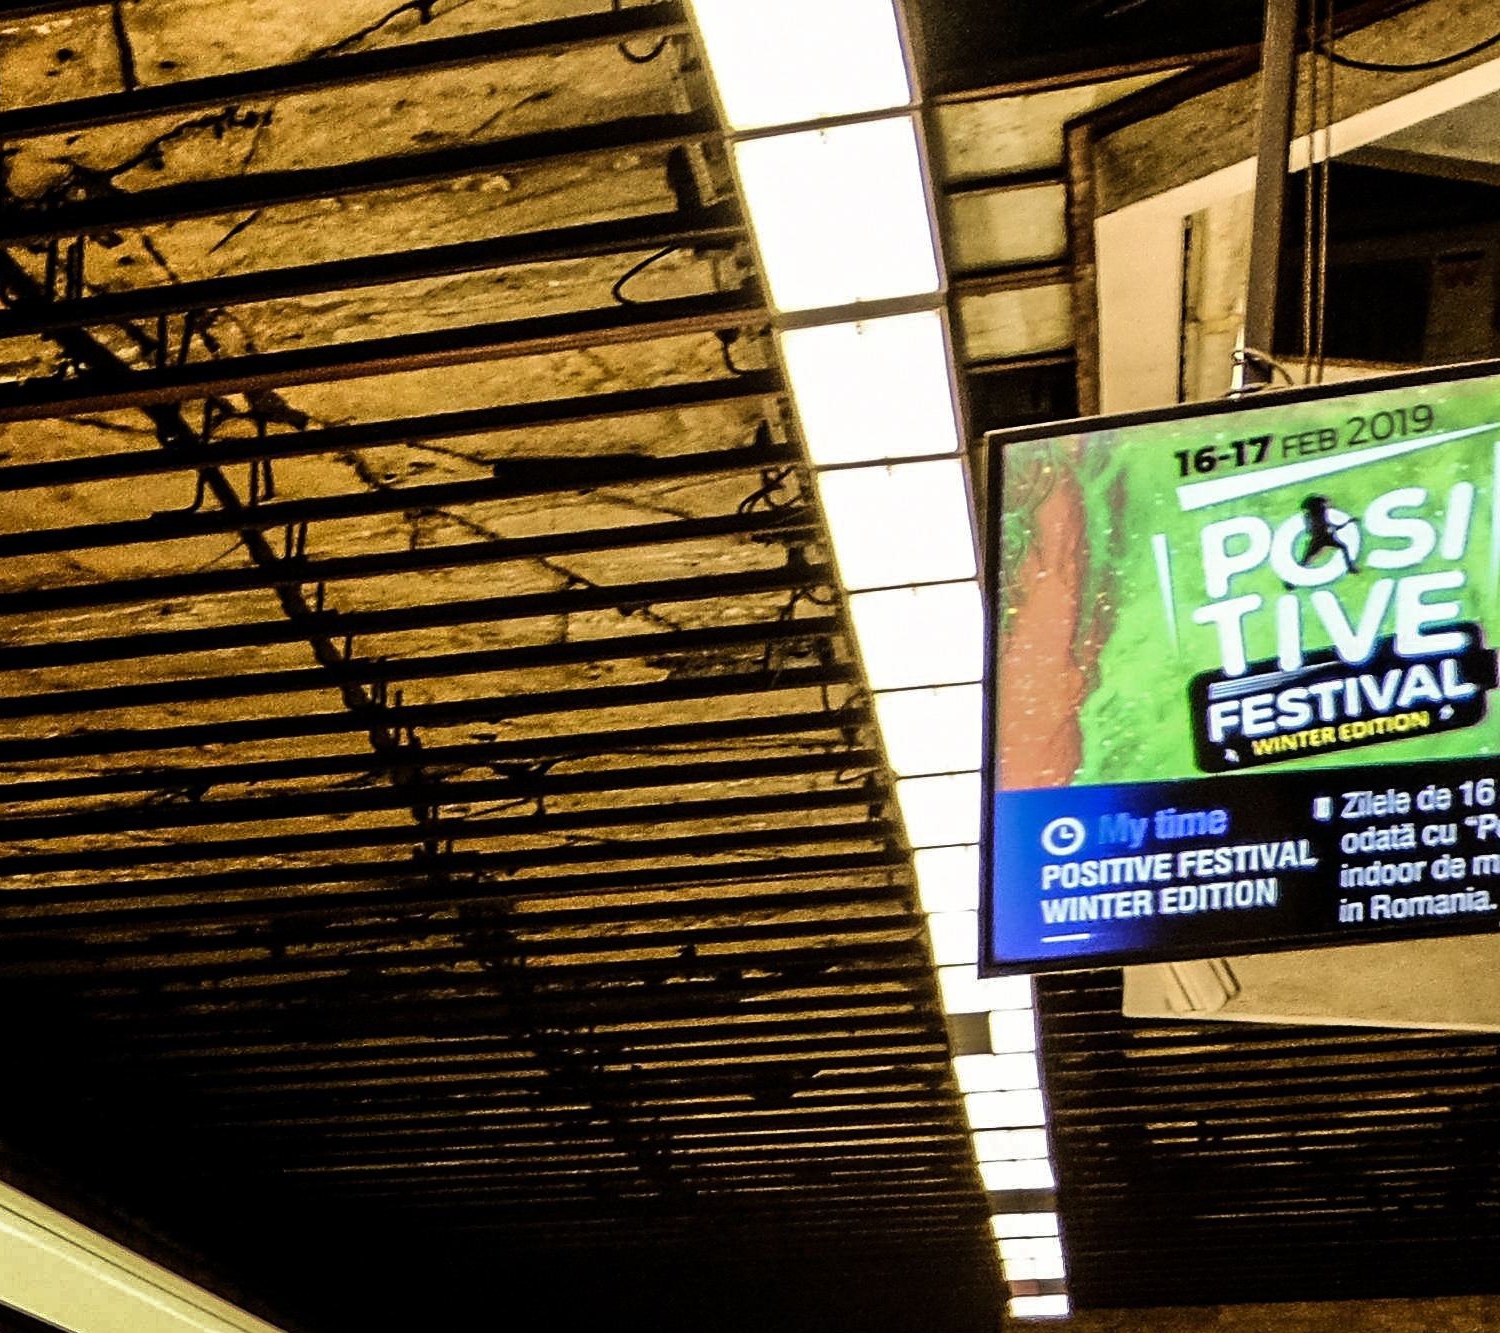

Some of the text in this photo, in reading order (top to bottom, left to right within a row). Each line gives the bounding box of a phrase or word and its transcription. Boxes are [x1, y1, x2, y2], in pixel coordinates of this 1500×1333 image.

[1174, 404, 1434, 477] 16-17 FEB 2019
[1201, 481, 1475, 599] POSI
[1192, 570, 1466, 678] TIVE
[1207, 658, 1477, 744] FESTIVAL
[1251, 711, 1430, 756] WINTER EDITION
[1340, 778, 1496, 819] Zilele de 16
[1099, 808, 1229, 849] My time
[1421, 823, 1458, 846] cu
[1041, 839, 1319, 891] POSITIVE FESTIVAL
[1339, 861, 1427, 888] indoor
[1431, 854, 1466, 880] de
[1040, 878, 1279, 924] WINTER EDITION
[1338, 887, 1498, 922] in Romania.
